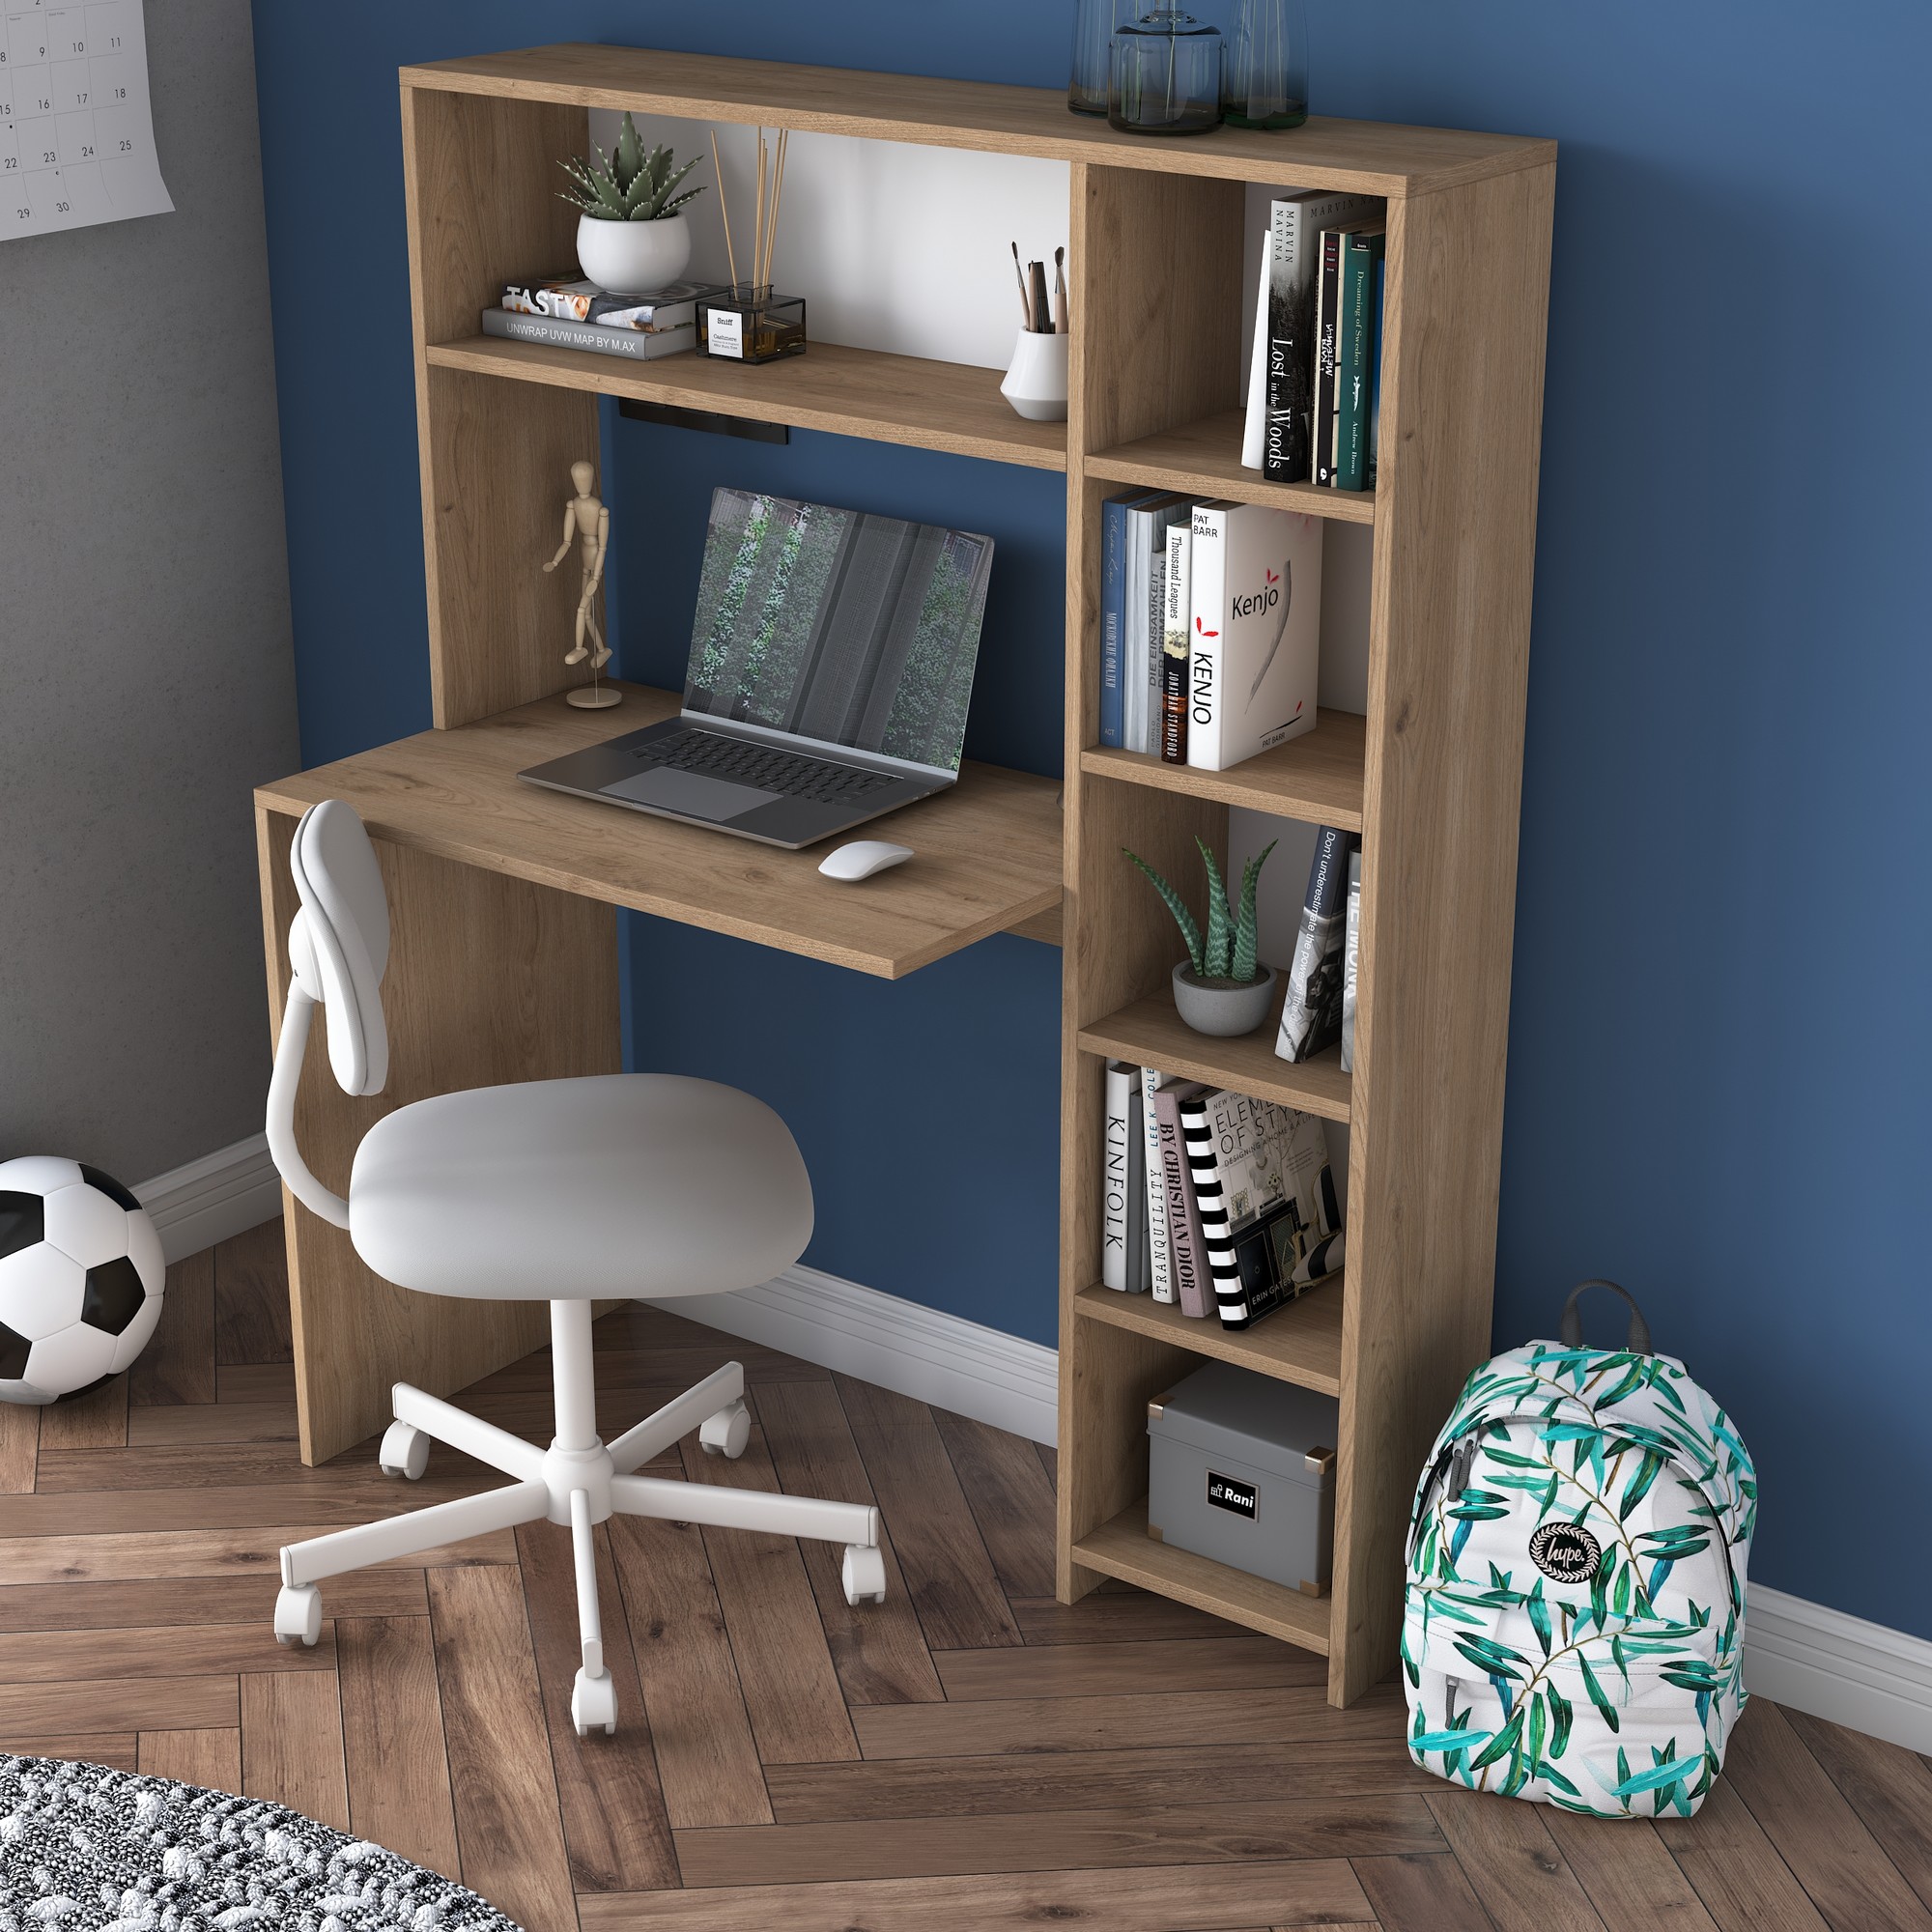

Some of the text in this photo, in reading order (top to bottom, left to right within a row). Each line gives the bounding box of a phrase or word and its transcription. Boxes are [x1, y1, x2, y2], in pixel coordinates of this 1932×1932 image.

[0, 37, 121, 62] 8 9 10 11
[0, 88, 127, 115] 15 16 17 18
[5, 140, 132, 169] 22 23 24 25
[17, 201, 70, 219] 29 30
[1310, 197, 1353, 218] MARVIN
[1275, 210, 1284, 261] NAVINA
[1285, 211, 1294, 263] MARVIN
[506, 285, 579, 322] TASTY
[1354, 270, 1365, 366] Dreaming of Sweden
[506, 323, 548, 336] UNWRAP
[549, 329, 572, 343] UVW
[574, 332, 595, 346] MAP
[596, 336, 610, 349] BY
[717, 317, 733, 327] Sniff
[1268, 336, 1293, 469] Lost in the Woods
[1193, 514, 1209, 525] PAT
[1193, 526, 1218, 538] BARR
[1170, 536, 1182, 619] Thousand Leagues
[1232, 584, 1279, 620] Kenjo
[1149, 571, 1160, 687] DIE EINSAMKEIT
[1167, 671, 1179, 712] JONATHAN
[1193, 652, 1213, 725] KENJO
[1262, 732, 1286, 749] PAT BARR
[1283, 832, 1336, 1058] Don't underestimate the power of the dark side
[1146, 1067, 1155, 1099] COLE
[1213, 1097, 1228, 1111] NEW
[1150, 1125, 1158, 1148] LEE
[1220, 1125, 1245, 1154] OF
[1224, 1142, 1261, 1168] DESIGNING
[1268, 1127, 1288, 1141] HOME
[1105, 1116, 1125, 1251] KINFOLK
[1160, 1123, 1196, 1290] BY CHRISTIAN DIOR
[1151, 1169, 1168, 1294] TRANQUILITY
[1252, 1290, 1268, 1305] ERIN
[1224, 1488, 1254, 1508] Rani
[1547, 1536, 1585, 1570] hype.
